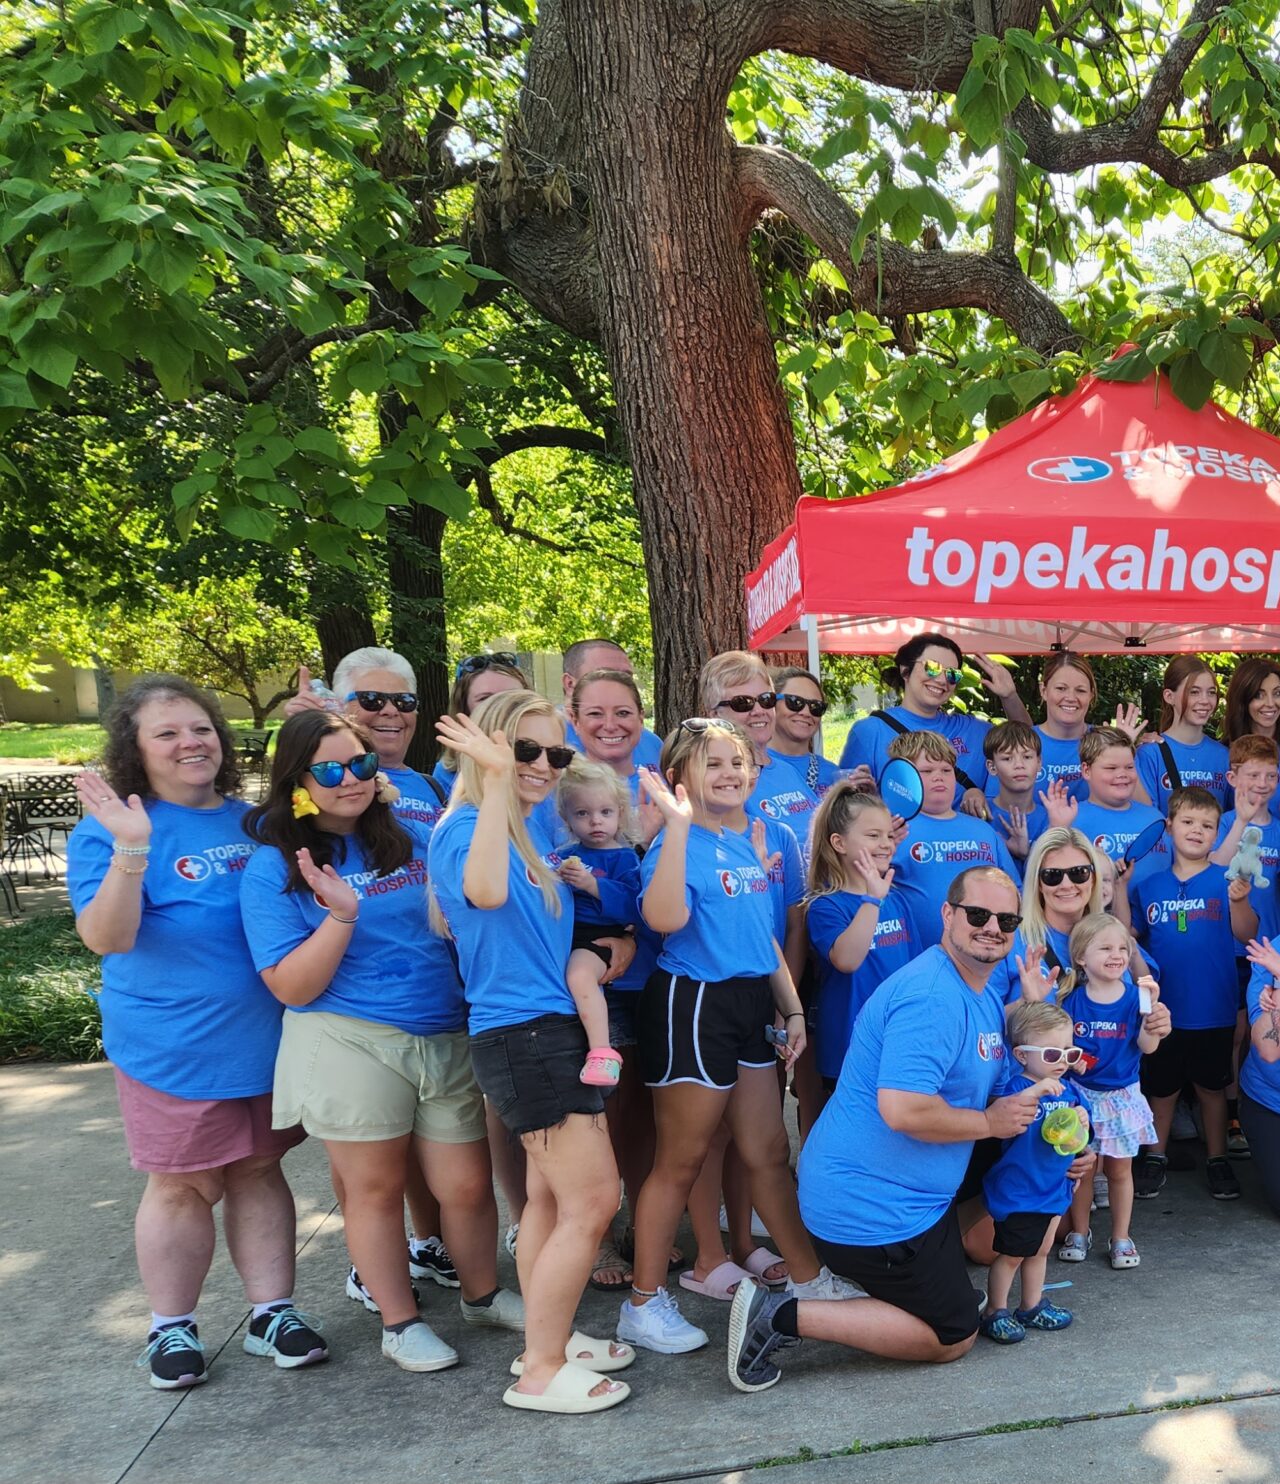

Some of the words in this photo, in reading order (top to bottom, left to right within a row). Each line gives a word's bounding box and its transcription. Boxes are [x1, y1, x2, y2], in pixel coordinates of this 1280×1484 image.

[1110, 445, 1275, 472] TOPEKA
[1047, 764, 1082, 774] TOPEK
[1179, 770, 1213, 781] TOPEKA
[393, 796, 434, 813] OPEKA
[932, 840, 979, 852] TOPEKA
[1117, 843, 1125, 854] &
[935, 851, 944, 863] &
[946, 850, 995, 865] HOSPITAL
[213, 862, 227, 876] &
[342, 866, 406, 890] TOPEA
[407, 859, 426, 872] ER
[365, 872, 428, 897] HOSPITA
[1161, 898, 1206, 911] TOPEKA
[1161, 911, 1169, 923] &
[1090, 1021, 1117, 1031] TPEKA
